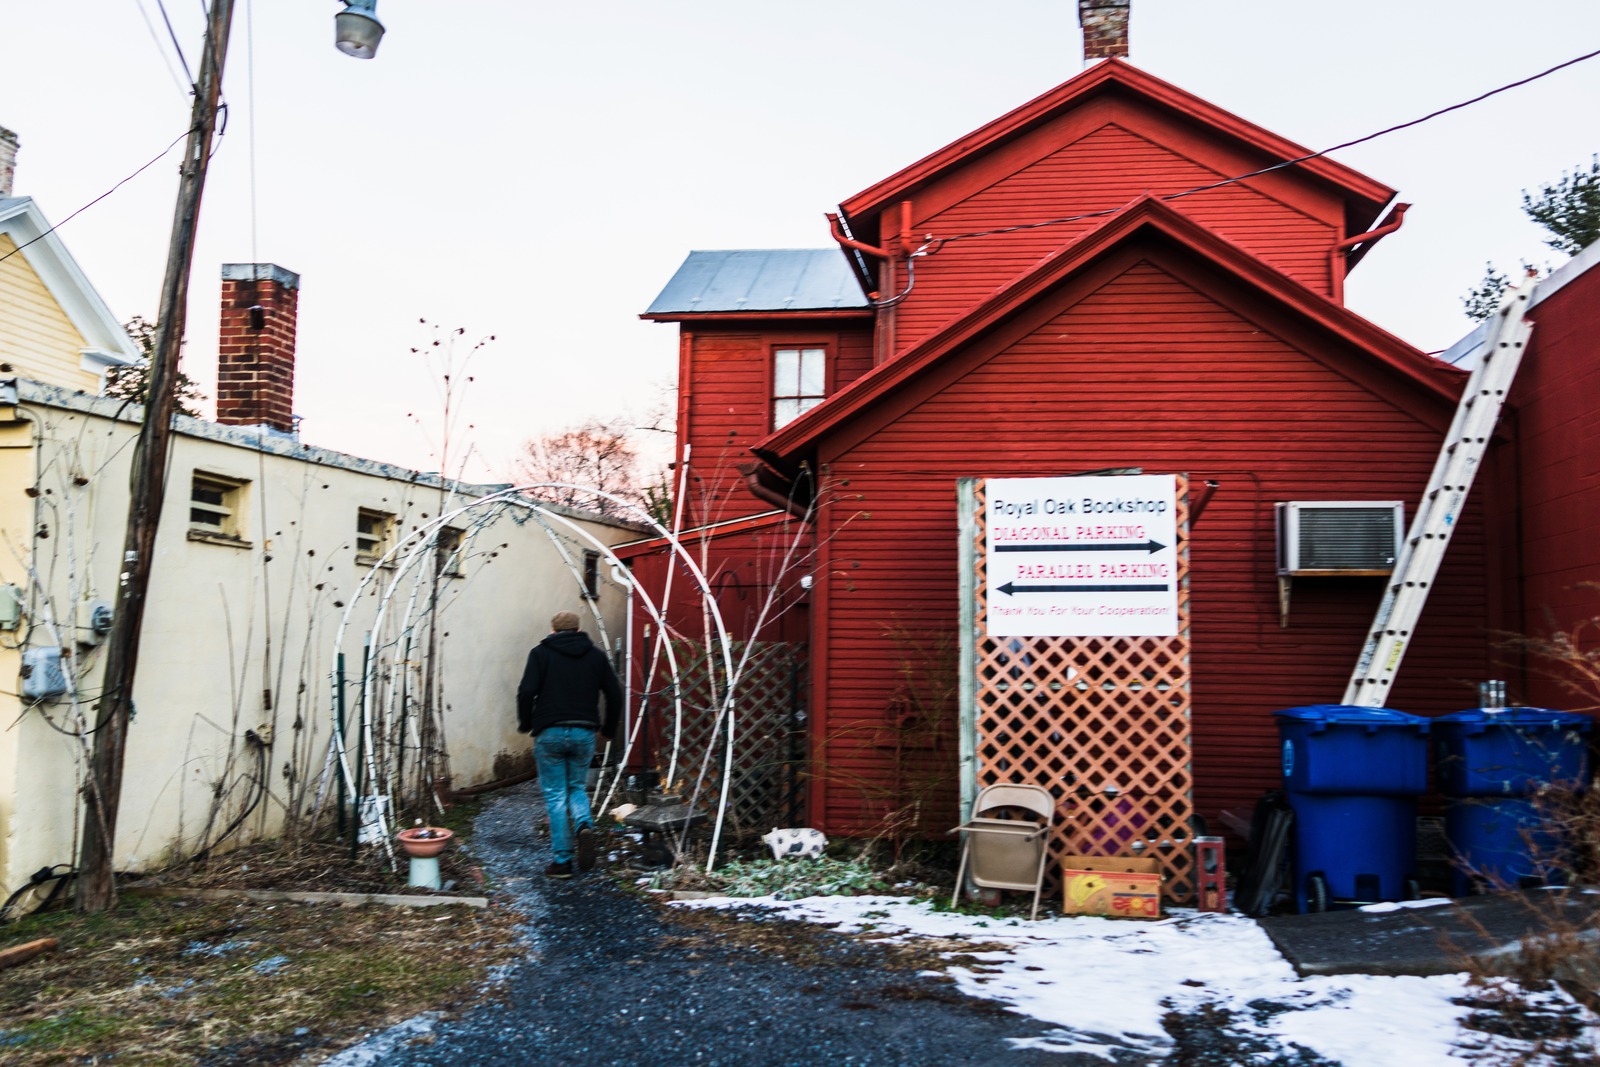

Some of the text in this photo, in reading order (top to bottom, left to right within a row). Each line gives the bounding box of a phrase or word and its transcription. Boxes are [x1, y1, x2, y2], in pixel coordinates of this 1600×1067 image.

[994, 497, 1168, 519] Royal Oak Bookshop
[994, 525, 1145, 541] DIAGONAL PARKING
[1017, 563, 1169, 579] PARALLEL PARKING
[992, 606, 1023, 616] Thank
[1026, 606, 1045, 616] You
[1049, 606, 1067, 616] For
[1070, 606, 1094, 616] Your
